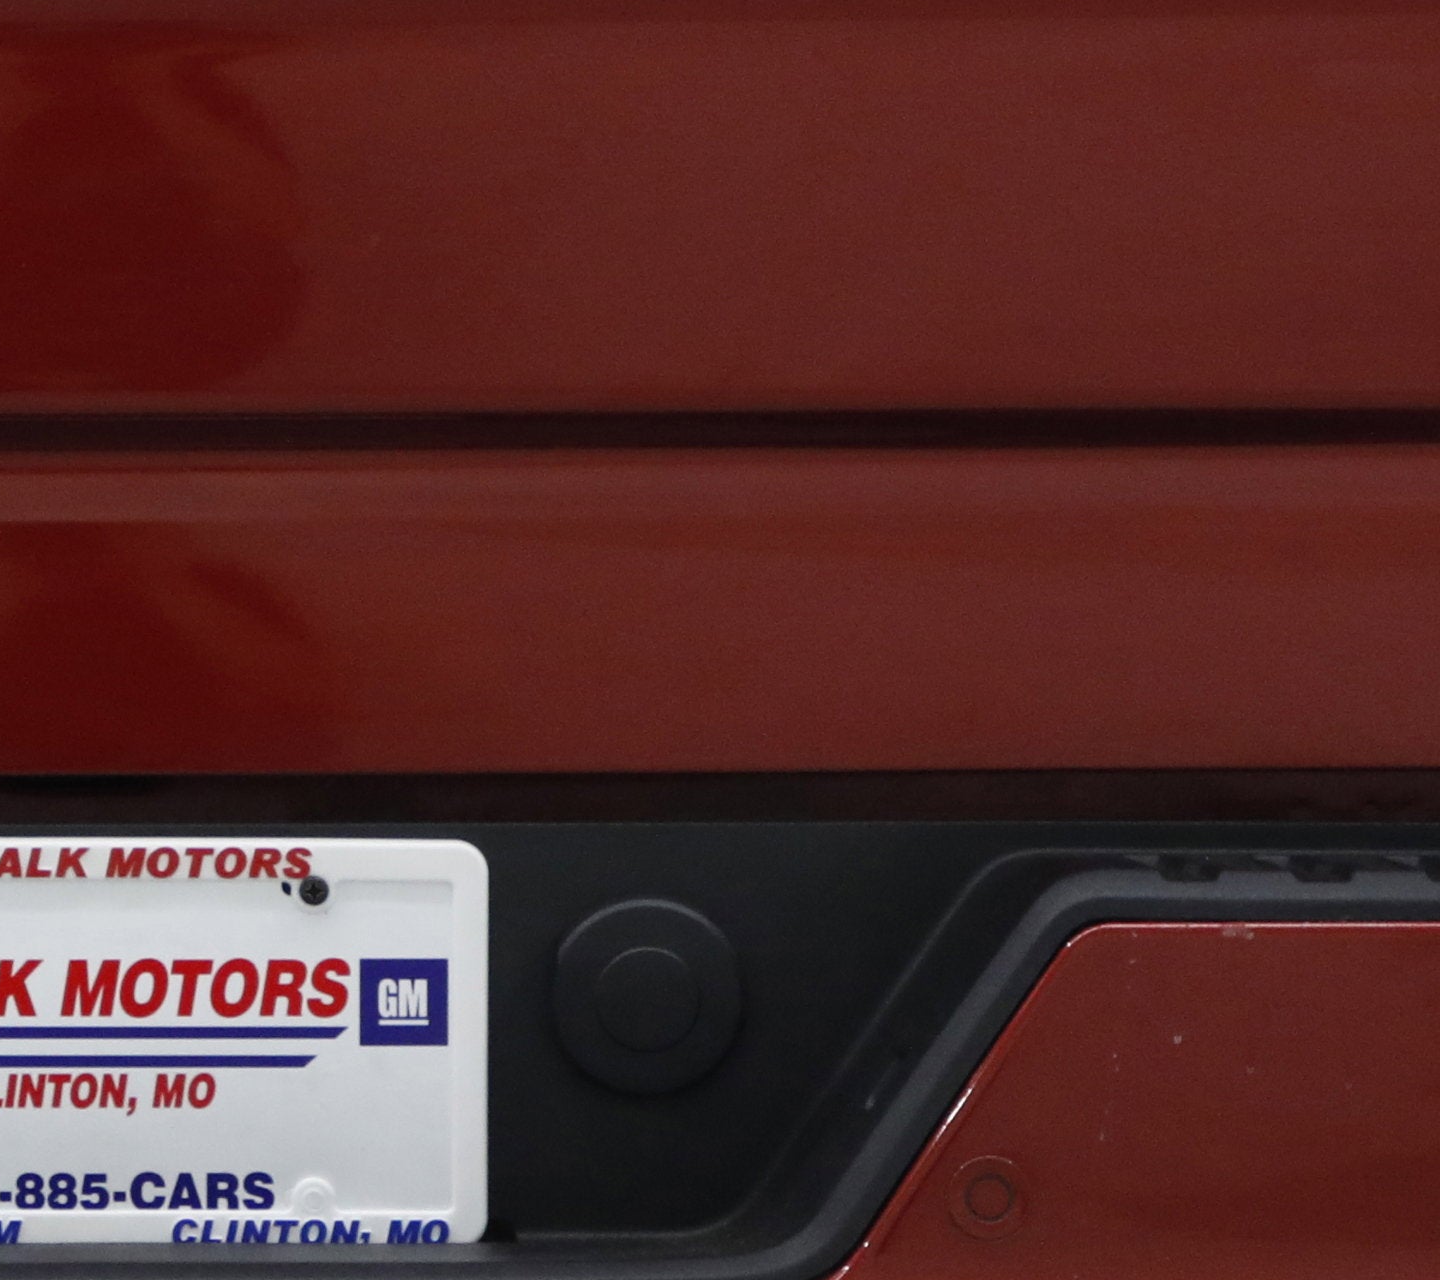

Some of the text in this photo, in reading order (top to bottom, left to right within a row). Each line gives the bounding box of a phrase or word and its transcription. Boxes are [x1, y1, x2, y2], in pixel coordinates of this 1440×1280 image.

[106, 847, 312, 878] MOTORS
[61, 957, 351, 1018] MOTORS
[377, 977, 429, 1019] GM
[153, 1073, 217, 1109] MO
[387, 1219, 450, 1244] MO
